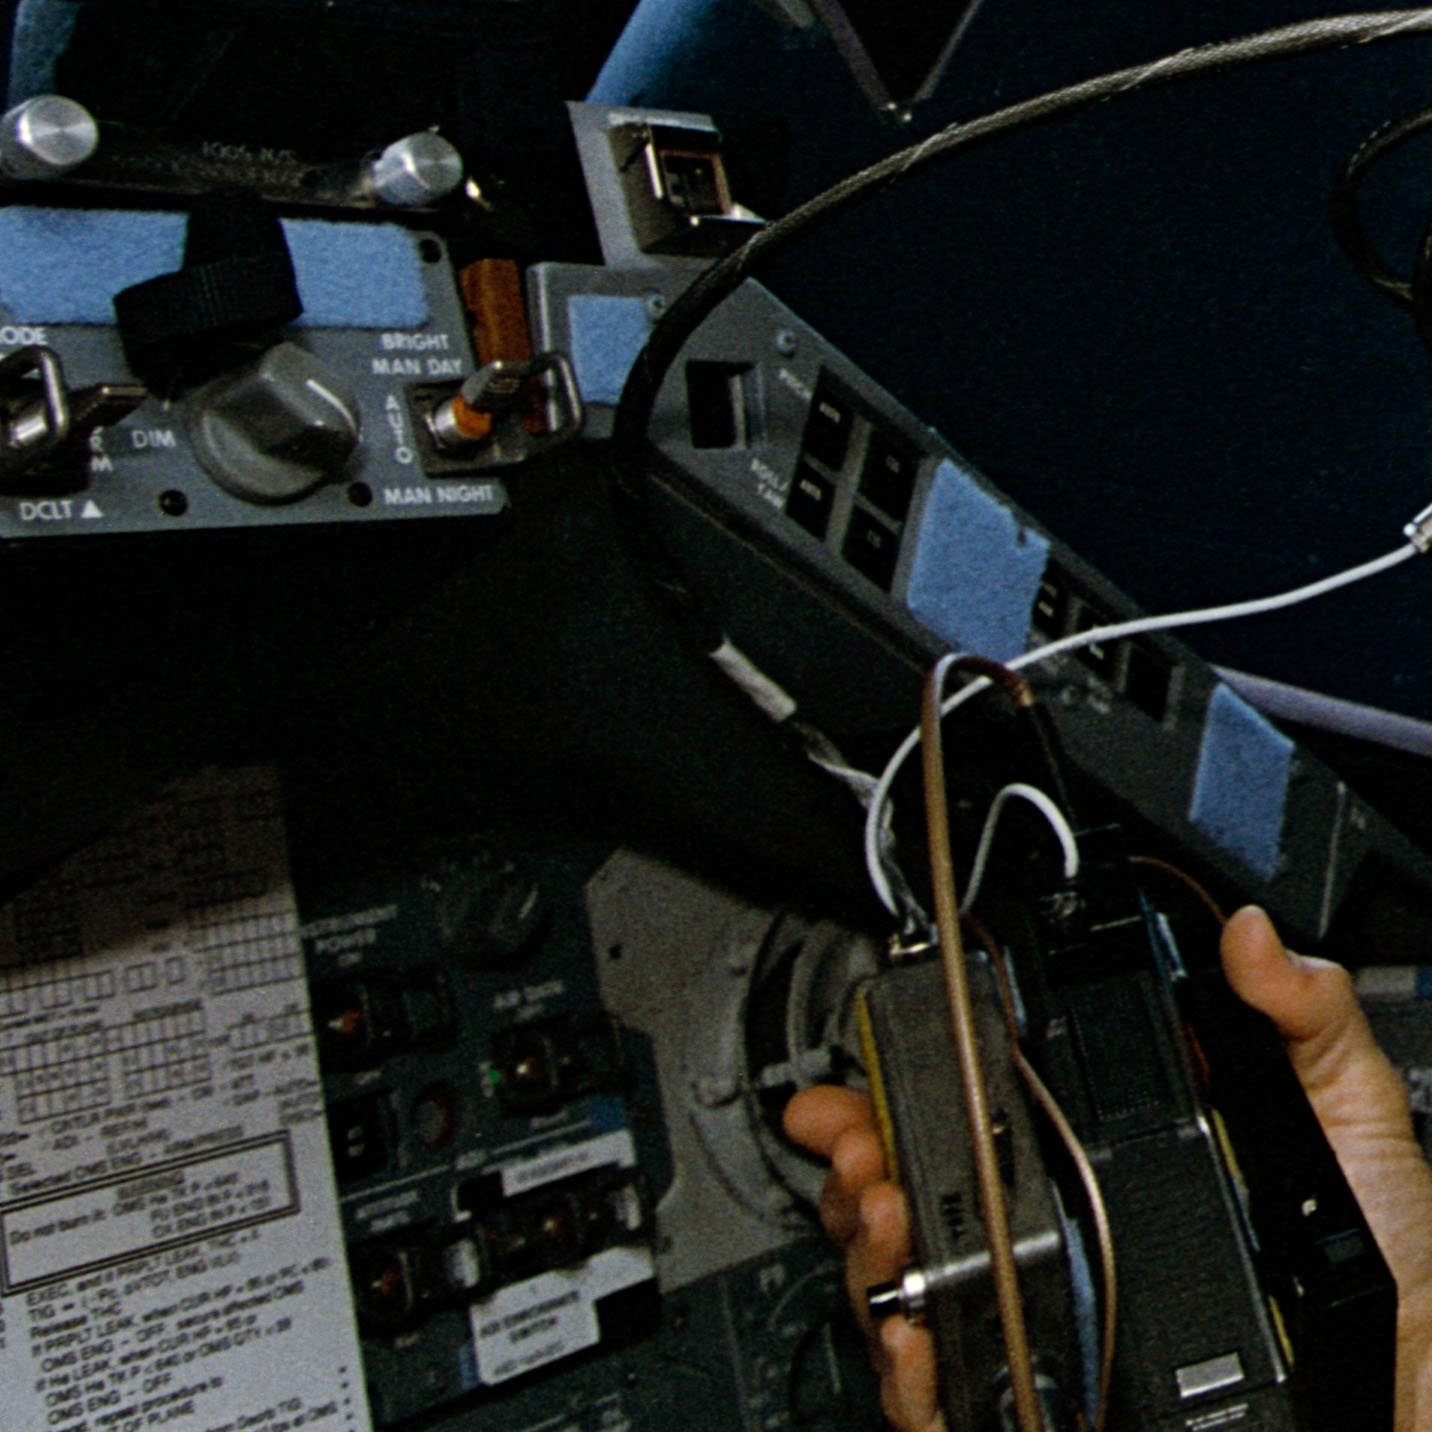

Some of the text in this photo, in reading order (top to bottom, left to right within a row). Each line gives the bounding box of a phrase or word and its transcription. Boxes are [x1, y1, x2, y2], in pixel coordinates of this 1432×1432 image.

[381, 333, 448, 350] BRIGHT
[372, 358, 462, 375] MAN DAY
[131, 430, 176, 449] DIM
[385, 395, 413, 465] AUTO
[384, 485, 494, 504] MAN NIGHT
[19, 500, 73, 520] DCLT
